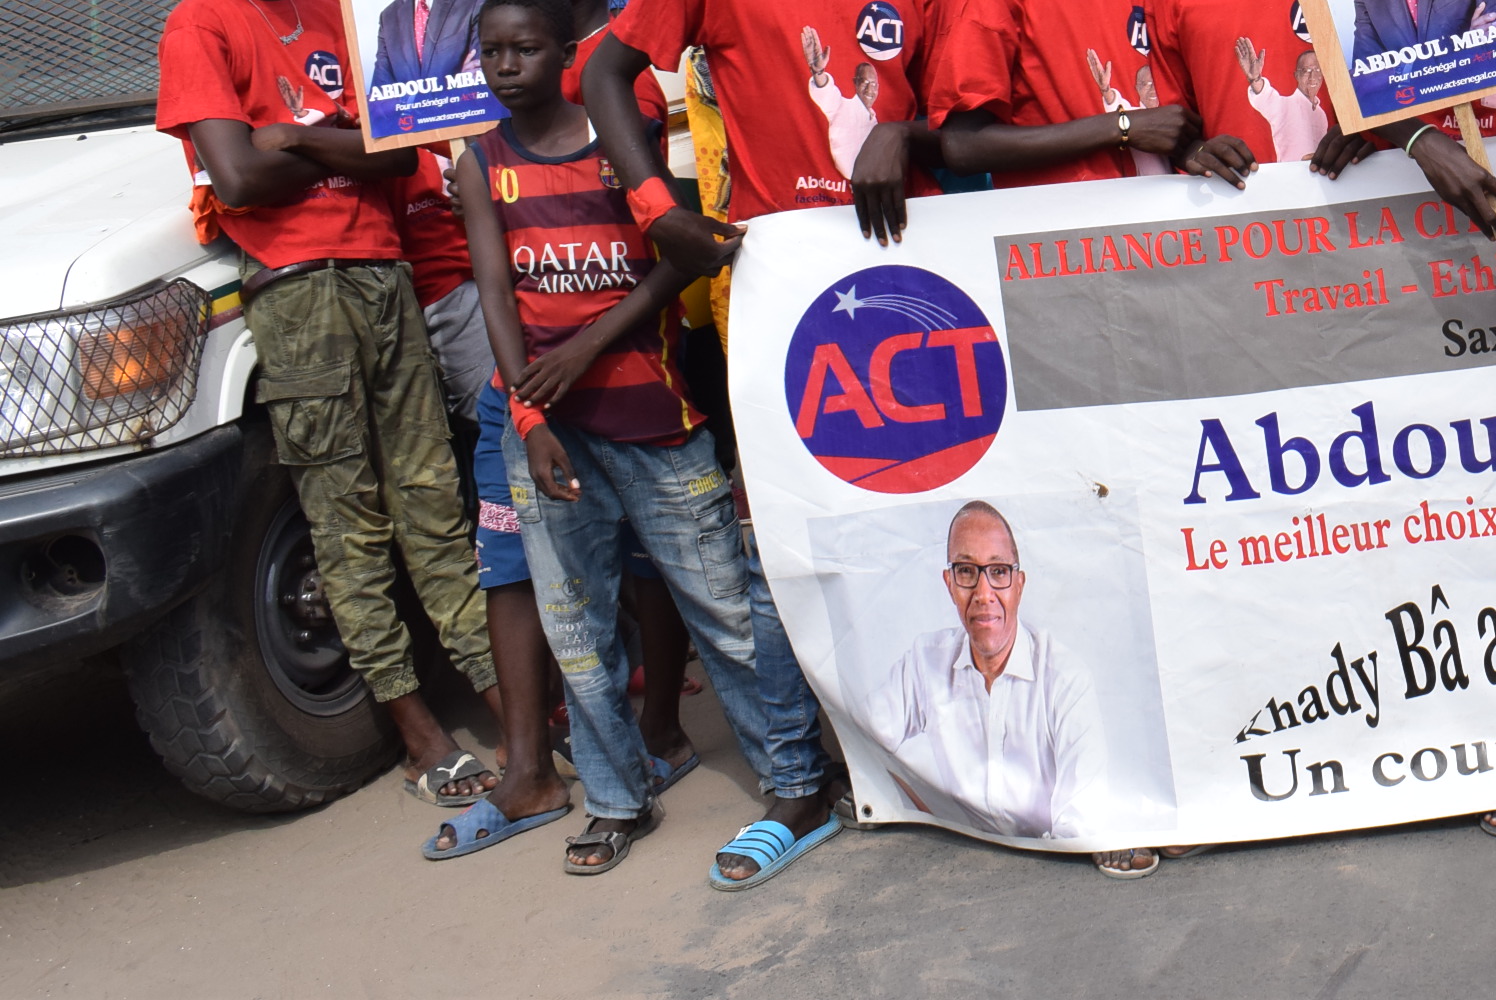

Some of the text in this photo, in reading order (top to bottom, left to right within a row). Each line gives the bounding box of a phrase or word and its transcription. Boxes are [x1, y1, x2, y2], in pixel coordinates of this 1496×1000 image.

[856, 15, 904, 44] ACT
[1353, 38, 1448, 77] ABDOUL
[1388, 71, 1410, 84] Pour
[1410, 69, 1423, 79] un
[1422, 59, 1457, 77] Sénégal
[1458, 57, 1471, 66] en
[368, 70, 487, 102] ABDOUL MBA
[1395, 86, 1415, 101] ACT
[395, 100, 412, 112] Pour
[421, 96, 449, 109] Sénégal
[449, 96, 460, 104] en
[398, 115, 415, 126] ACT
[1442, 113, 1493, 129] Aboul
[327, 175, 362, 189] MBA
[1003, 228, 1208, 282] ALLIANCE
[1216, 215, 1336, 263] POUR
[1344, 206, 1405, 249] LA
[513, 241, 631, 281] QATAR
[537, 272, 637, 294] AIRWAYS
[1254, 267, 1390, 318] Travail
[795, 325, 999, 439] ACT
[1180, 527, 1229, 571] Le
[1238, 512, 1391, 567] meilleur
[1384, 583, 1471, 700] Bâ
[1239, 747, 1350, 803] Un
